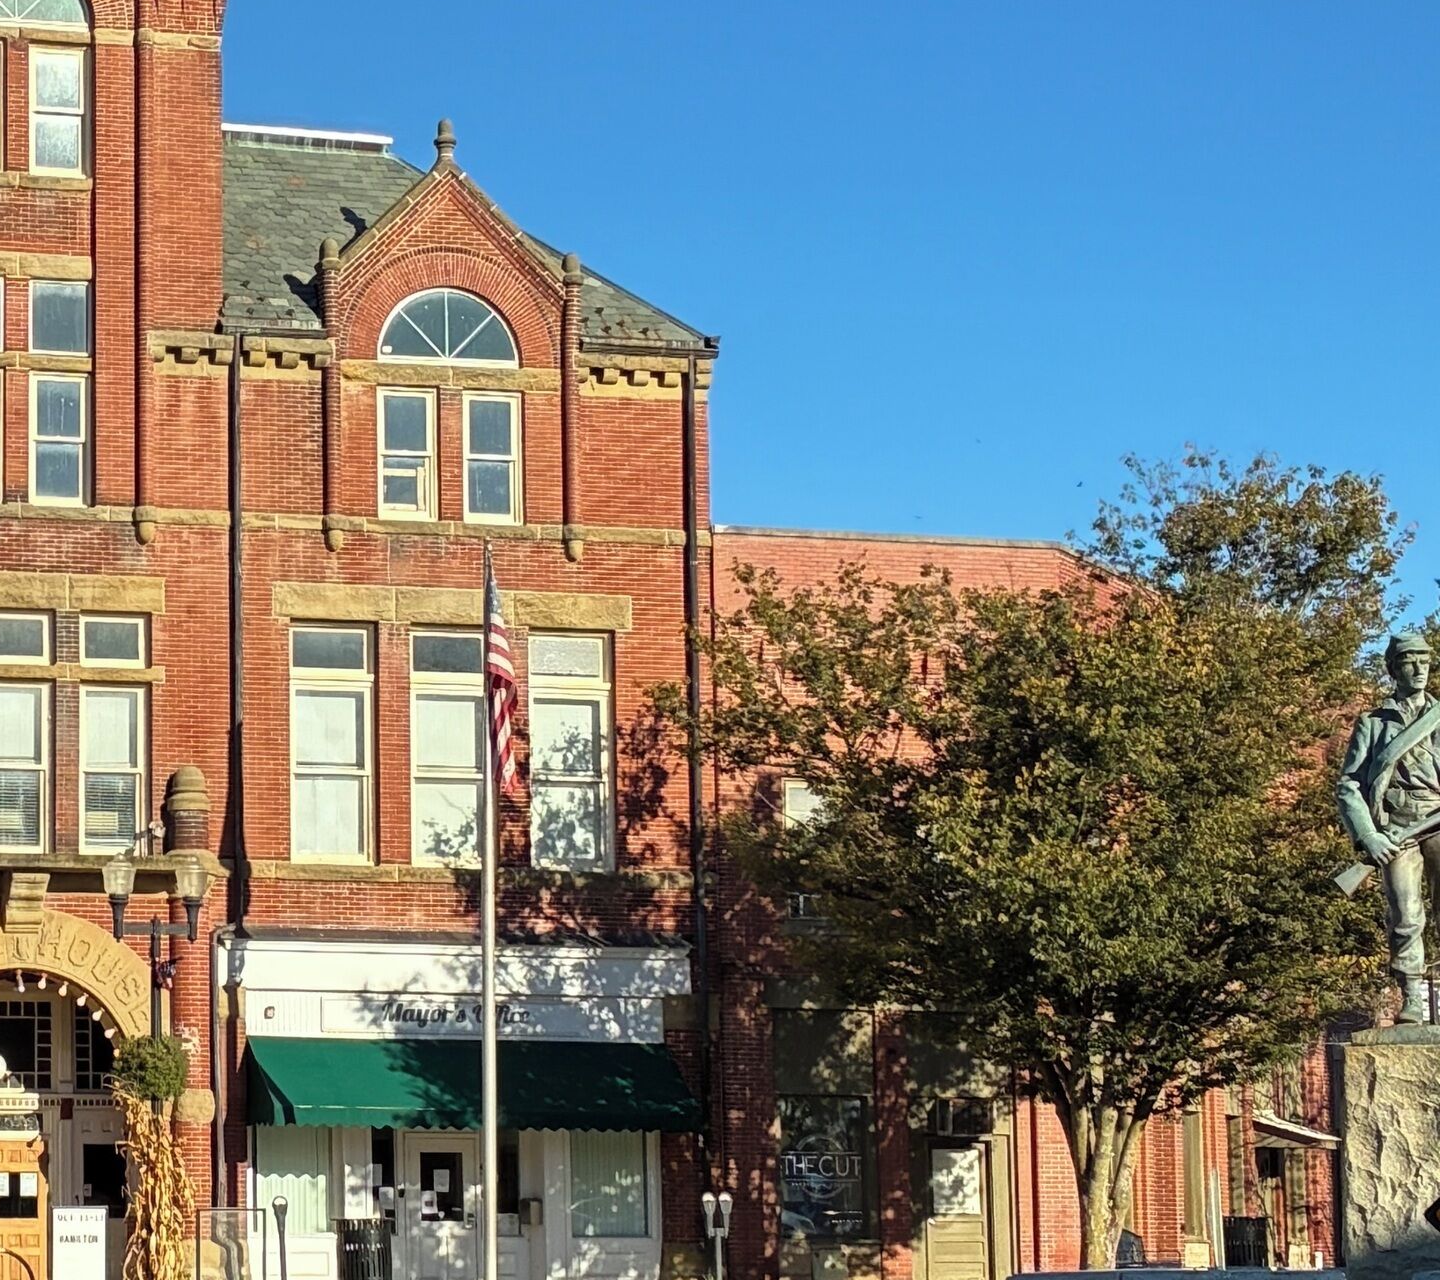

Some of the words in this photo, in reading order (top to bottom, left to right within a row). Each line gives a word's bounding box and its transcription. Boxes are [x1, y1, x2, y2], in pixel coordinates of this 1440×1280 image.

[382, 1001, 466, 1028] Mayor's
[781, 1155, 818, 1176] THE
[819, 1155, 862, 1176] CUT
